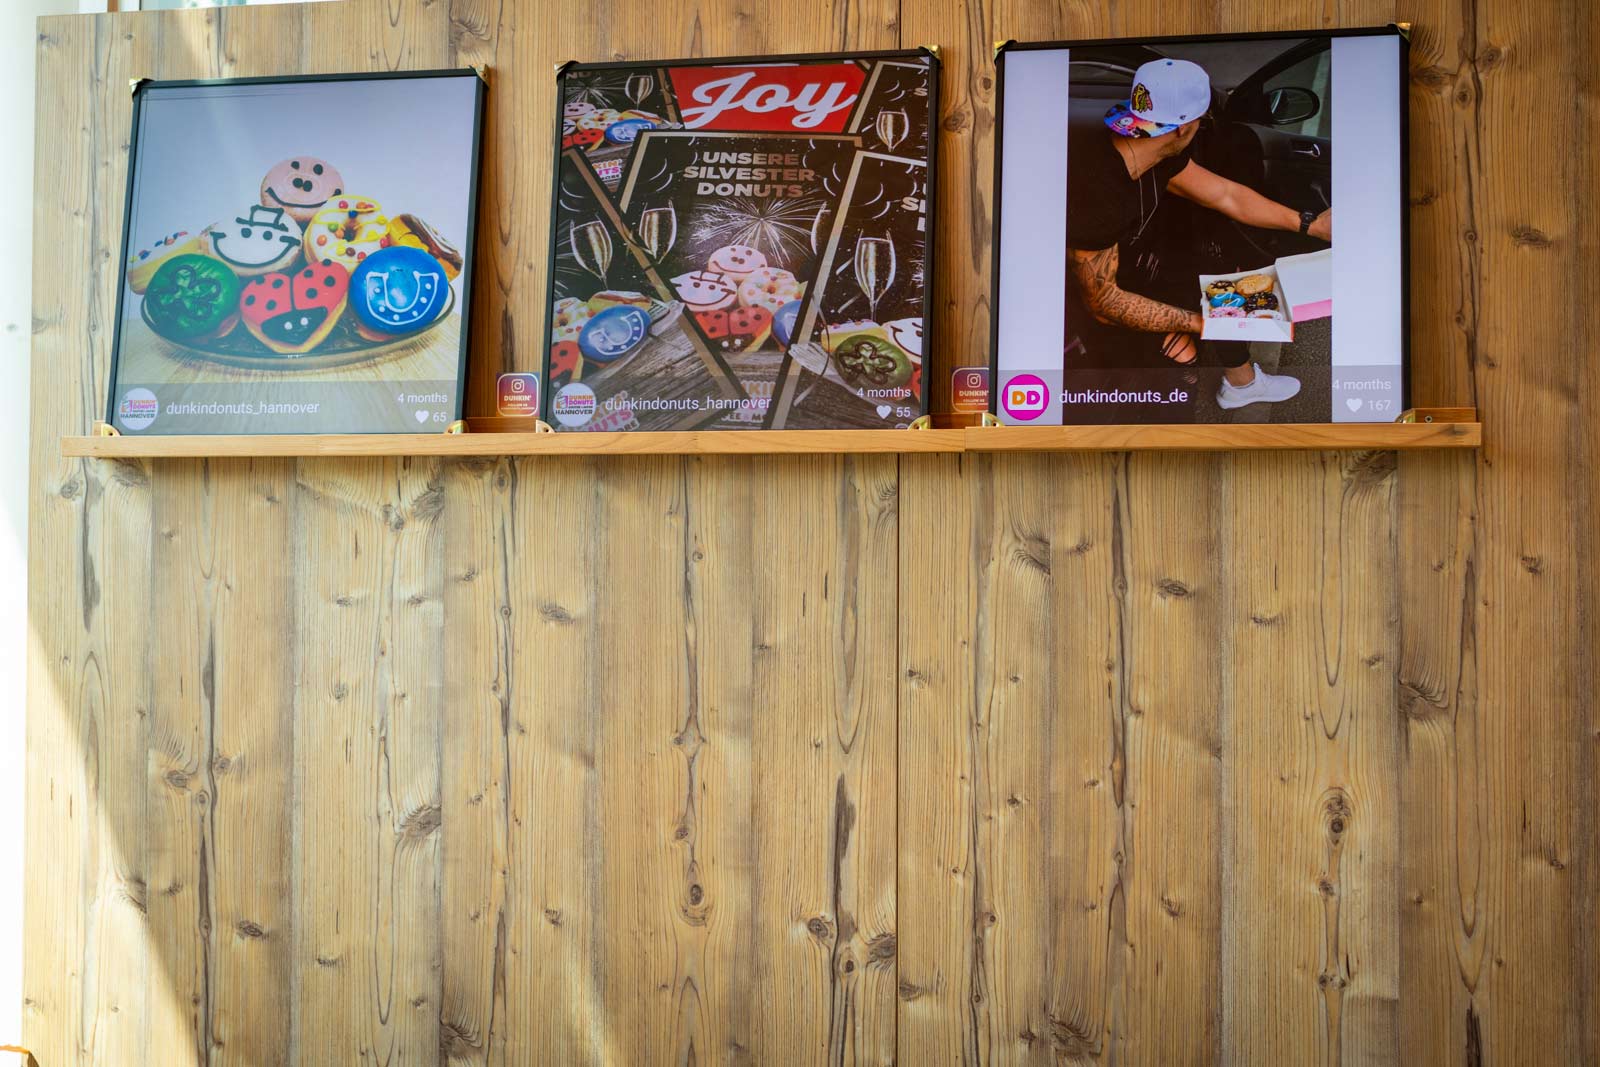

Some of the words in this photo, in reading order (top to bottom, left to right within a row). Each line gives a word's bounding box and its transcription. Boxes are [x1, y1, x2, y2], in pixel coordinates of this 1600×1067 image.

[681, 71, 857, 129] Joy
[702, 151, 800, 165] UNSERE
[683, 166, 815, 181] SILVESTER
[697, 182, 803, 197] DONUTS
[1343, 378, 1392, 390] months
[398, 393, 404, 403] 4
[407, 392, 448, 404] months
[856, 387, 864, 398] 4
[867, 386, 912, 398] months
[1058, 388, 1188, 405] dunkindonuts_de
[166, 401, 320, 415] dunkindonuts_hannover
[605, 396, 773, 411] dunkindonuts_hannover
[1368, 399, 1391, 411] 167
[432, 411, 447, 423] 65
[896, 406, 911, 418] 55
